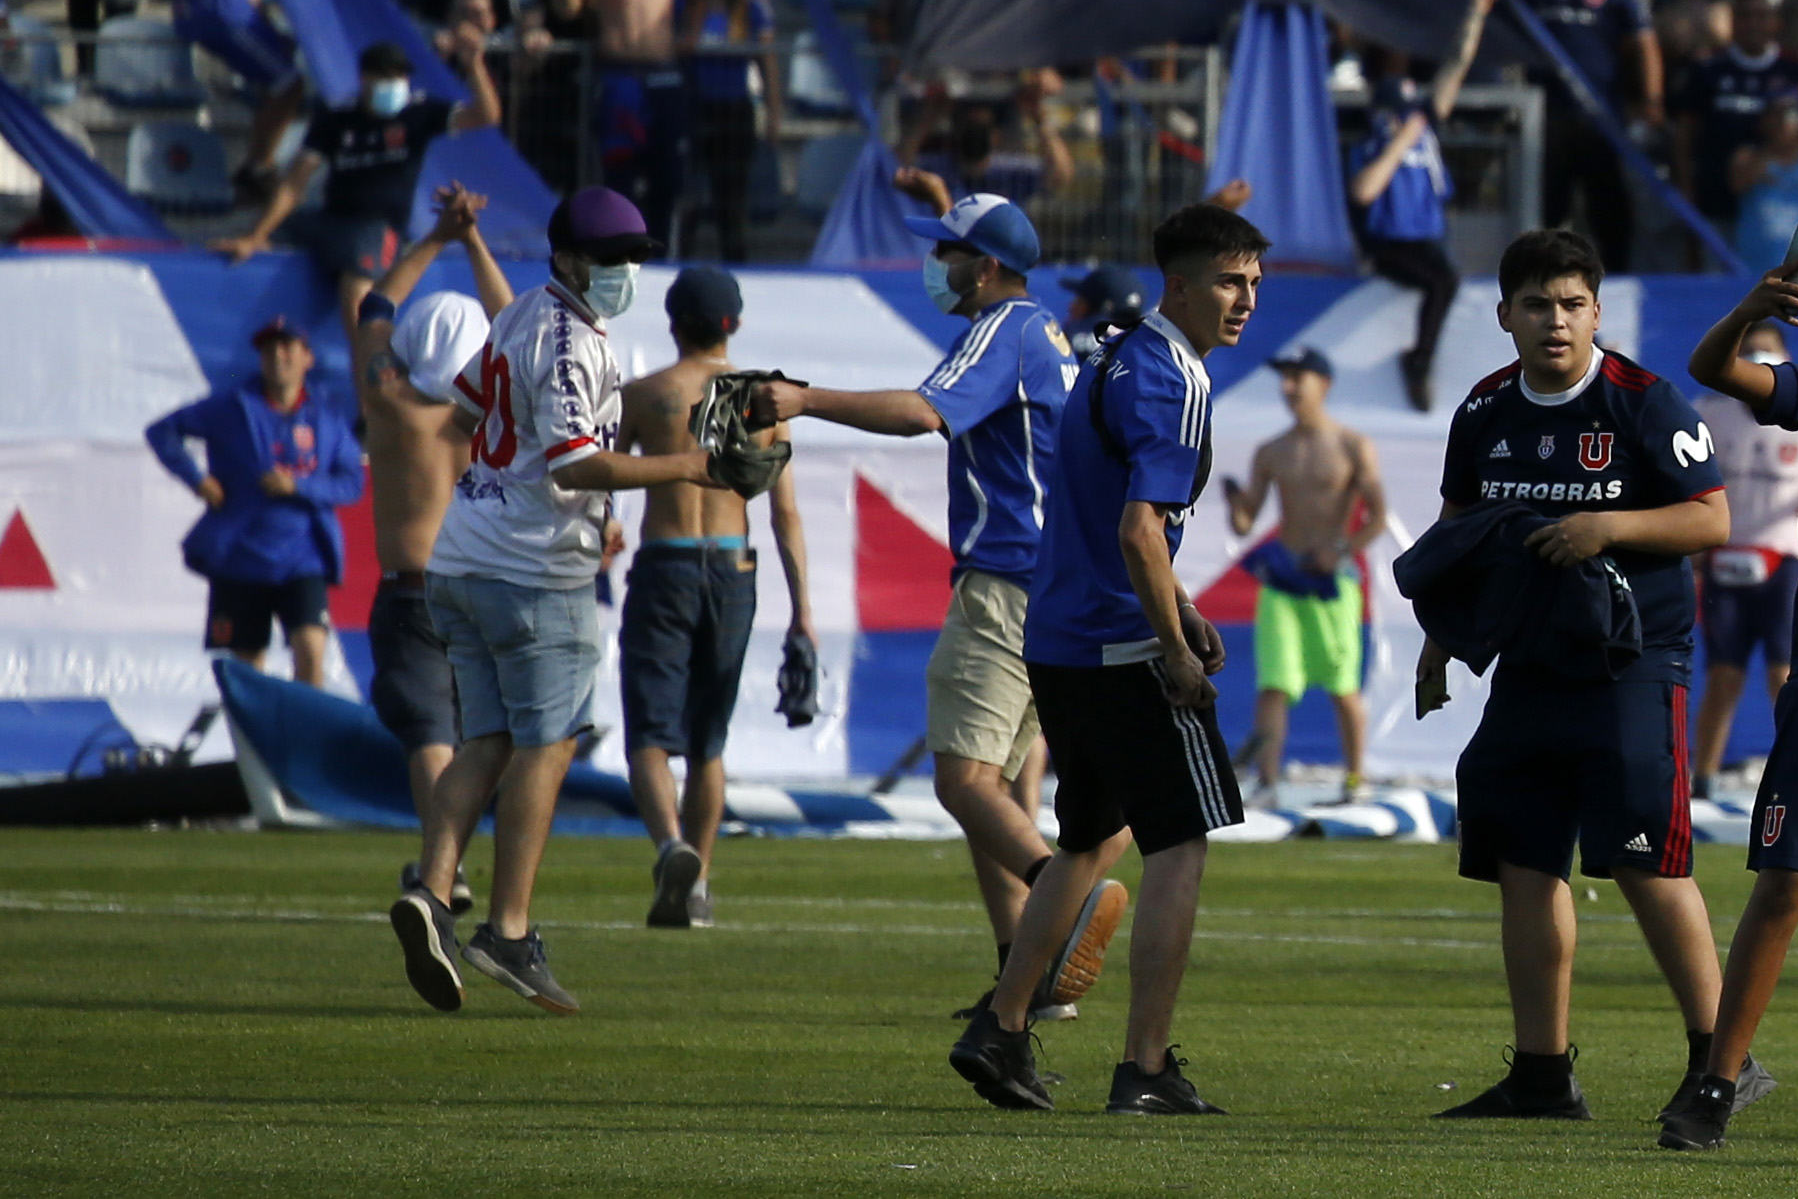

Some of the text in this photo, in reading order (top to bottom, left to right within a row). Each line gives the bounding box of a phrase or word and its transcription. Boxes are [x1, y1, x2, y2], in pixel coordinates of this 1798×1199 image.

[1578, 433, 1614, 471] U
[1481, 480, 1623, 501] PETROBRAS
[1761, 805, 1786, 847] U
